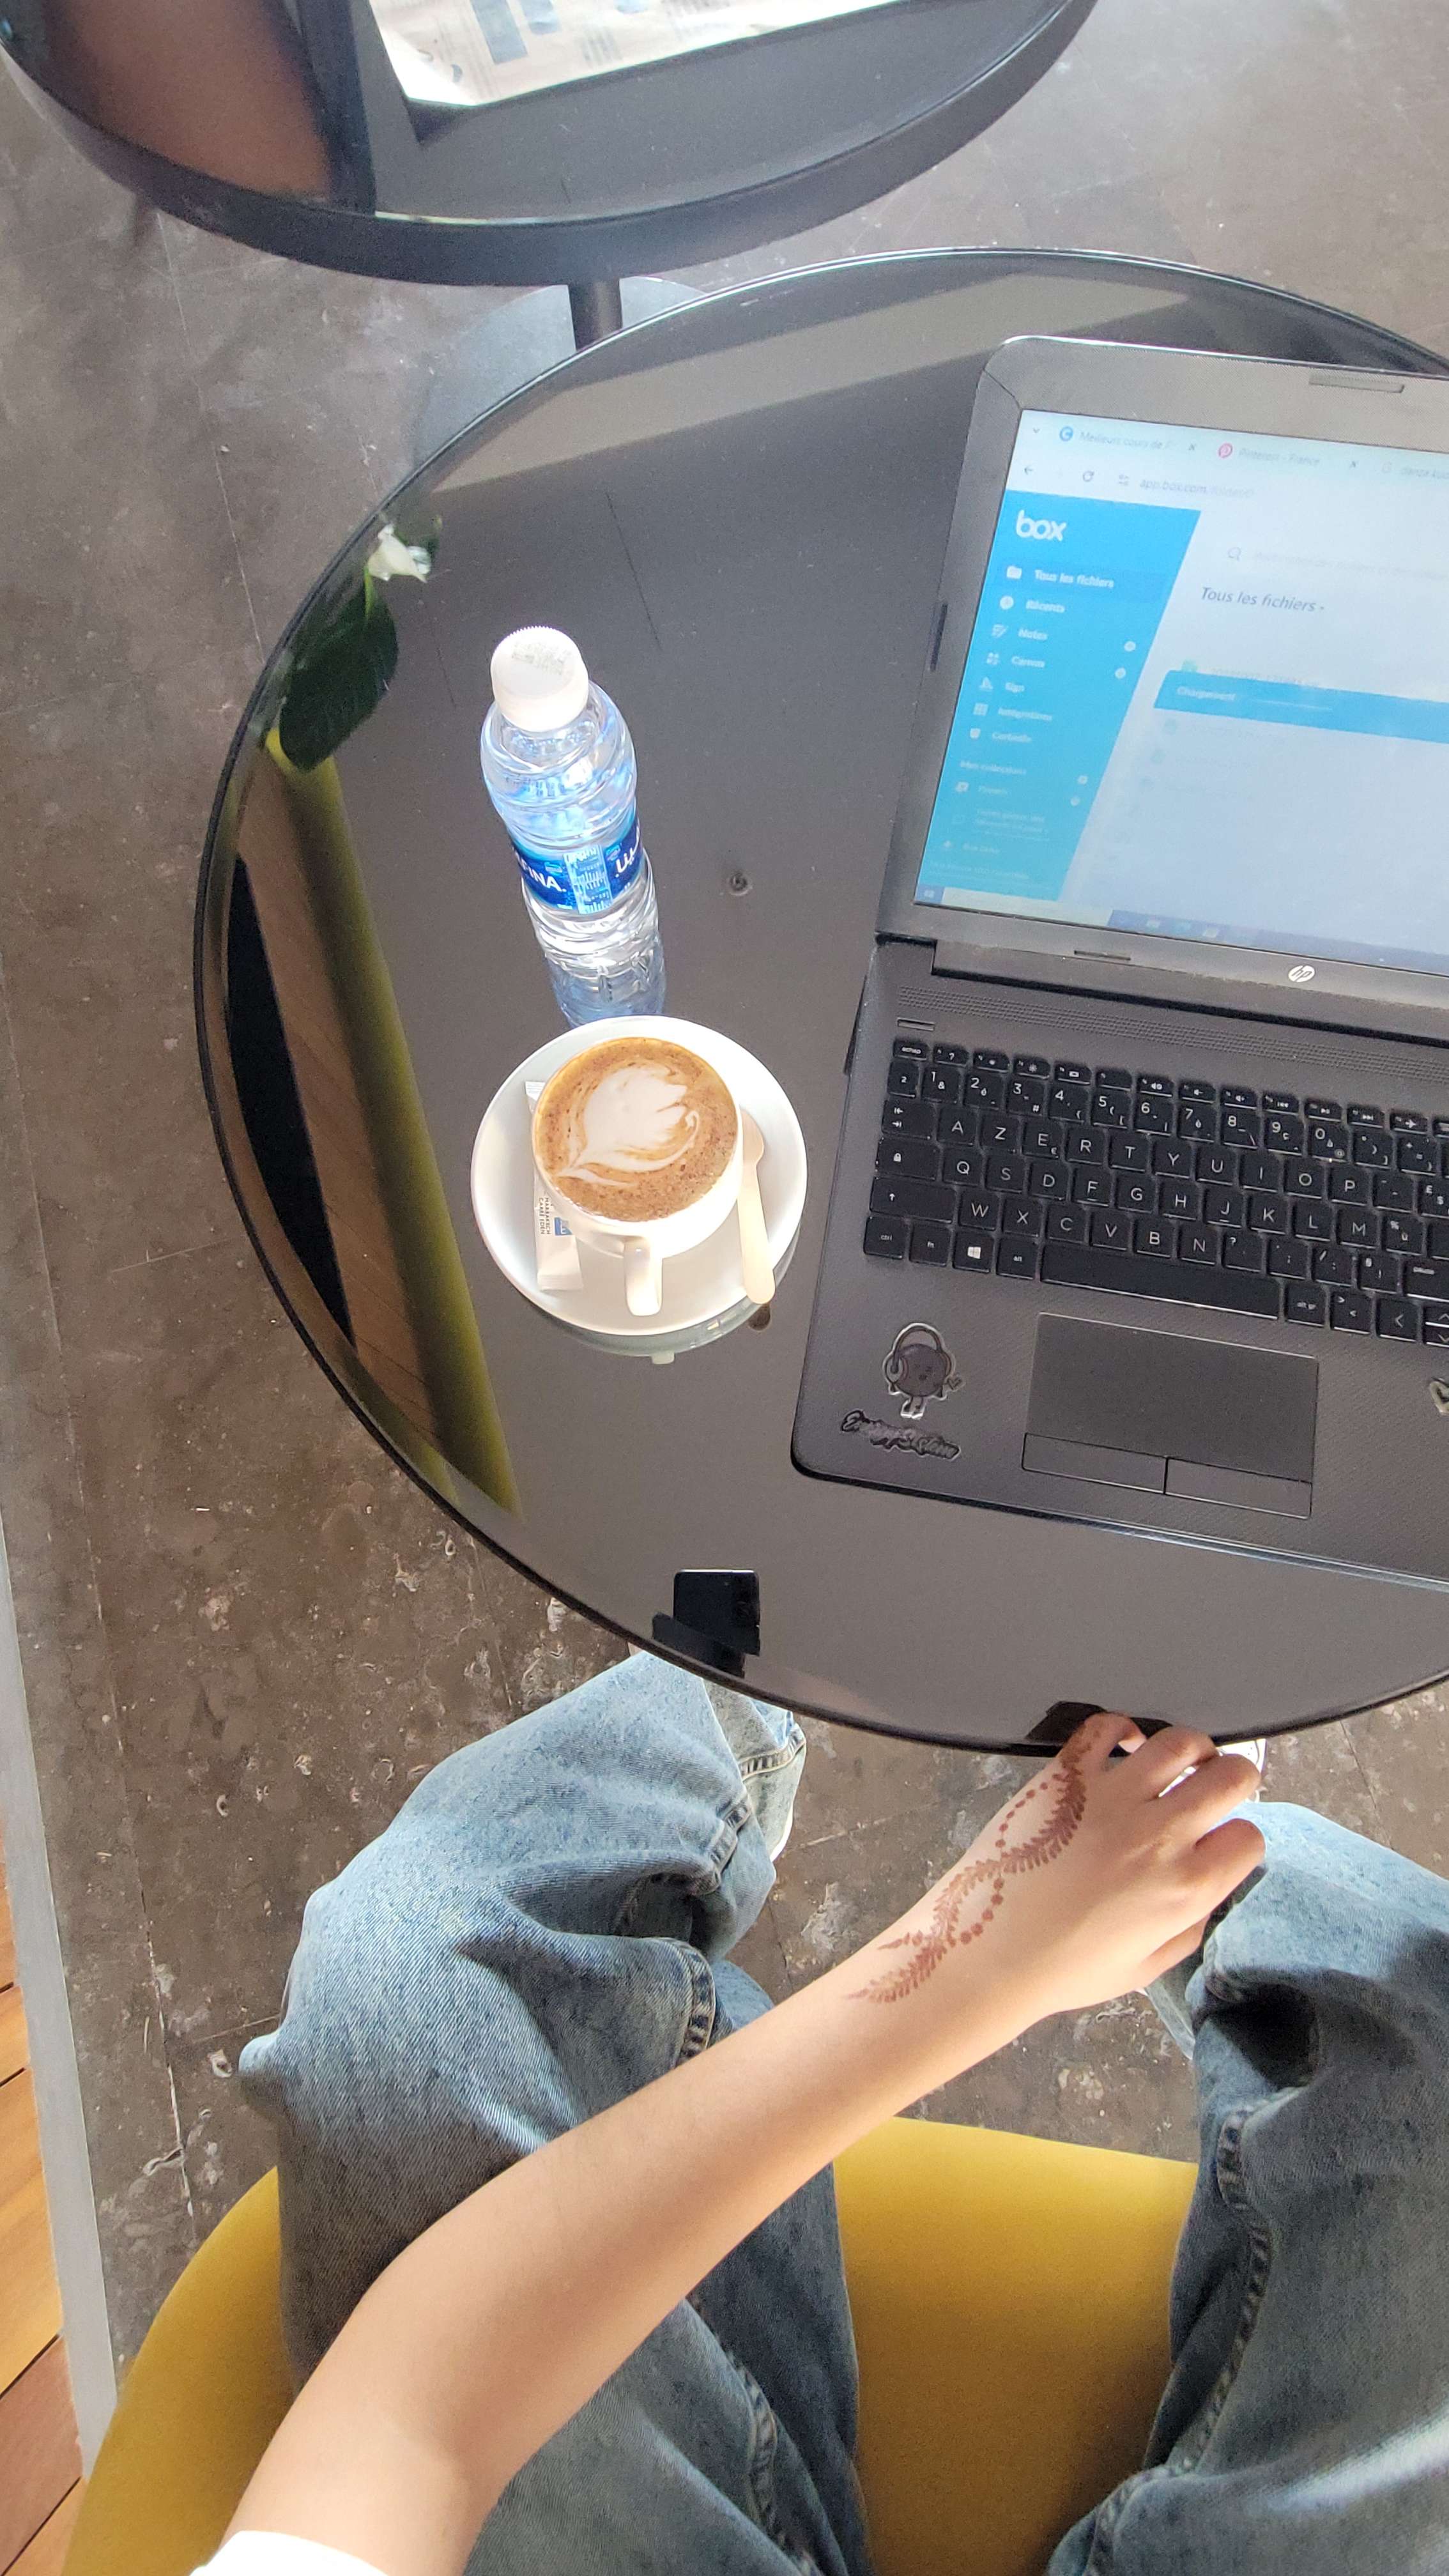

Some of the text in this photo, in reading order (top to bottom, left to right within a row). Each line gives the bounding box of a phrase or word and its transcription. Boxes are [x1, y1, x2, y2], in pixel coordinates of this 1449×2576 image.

[1016, 509, 1067, 541] box
[1076, 574, 1115, 588] fichiers
[1201, 586, 1317, 613] Tous les fichiers
[1288, 965, 1315, 983] hp
[931, 1071, 936, 1082] 1
[938, 1081, 945, 1089] &
[970, 1077, 979, 1089] 2
[1013, 1083, 1022, 1094] 3
[1055, 1090, 1064, 1101] 4
[1098, 1096, 1107, 1107] 5
[1141, 1102, 1150, 1114] 6
[1185, 1108, 1193, 1119] 7
[1227, 1115, 1237, 1127] 8
[1271, 1121, 1281, 1133] 9
[951, 1121, 963, 1133] A
[995, 1126, 1006, 1140] Z
[1038, 1133, 1048, 1146] E
[1080, 1139, 1091, 1153] R
[1125, 1146, 1135, 1159] T
[1168, 1153, 1179, 1166] Y
[1211, 1159, 1223, 1173] U
[1298, 1173, 1312, 1186] O
[1344, 1179, 1356, 1192] P
[956, 1161, 970, 1175] Q
[1000, 1167, 1011, 1181] S
[1042, 1174, 1055, 1187] D
[1087, 1180, 1098, 1193] F
[1130, 1188, 1143, 1201] G
[1175, 1194, 1186, 1208] H
[1221, 1202, 1230, 1215] J
[1263, 1208, 1275, 1222] K
[1308, 1215, 1318, 1229] L
[1352, 1222, 1366, 1236] M
[971, 1203, 989, 1218] W
[1016, 1210, 1029, 1224] X
[1060, 1217, 1073, 1231] C
[1105, 1223, 1117, 1238] V
[1149, 1231, 1160, 1245] B
[1193, 1238, 1206, 1252] N
